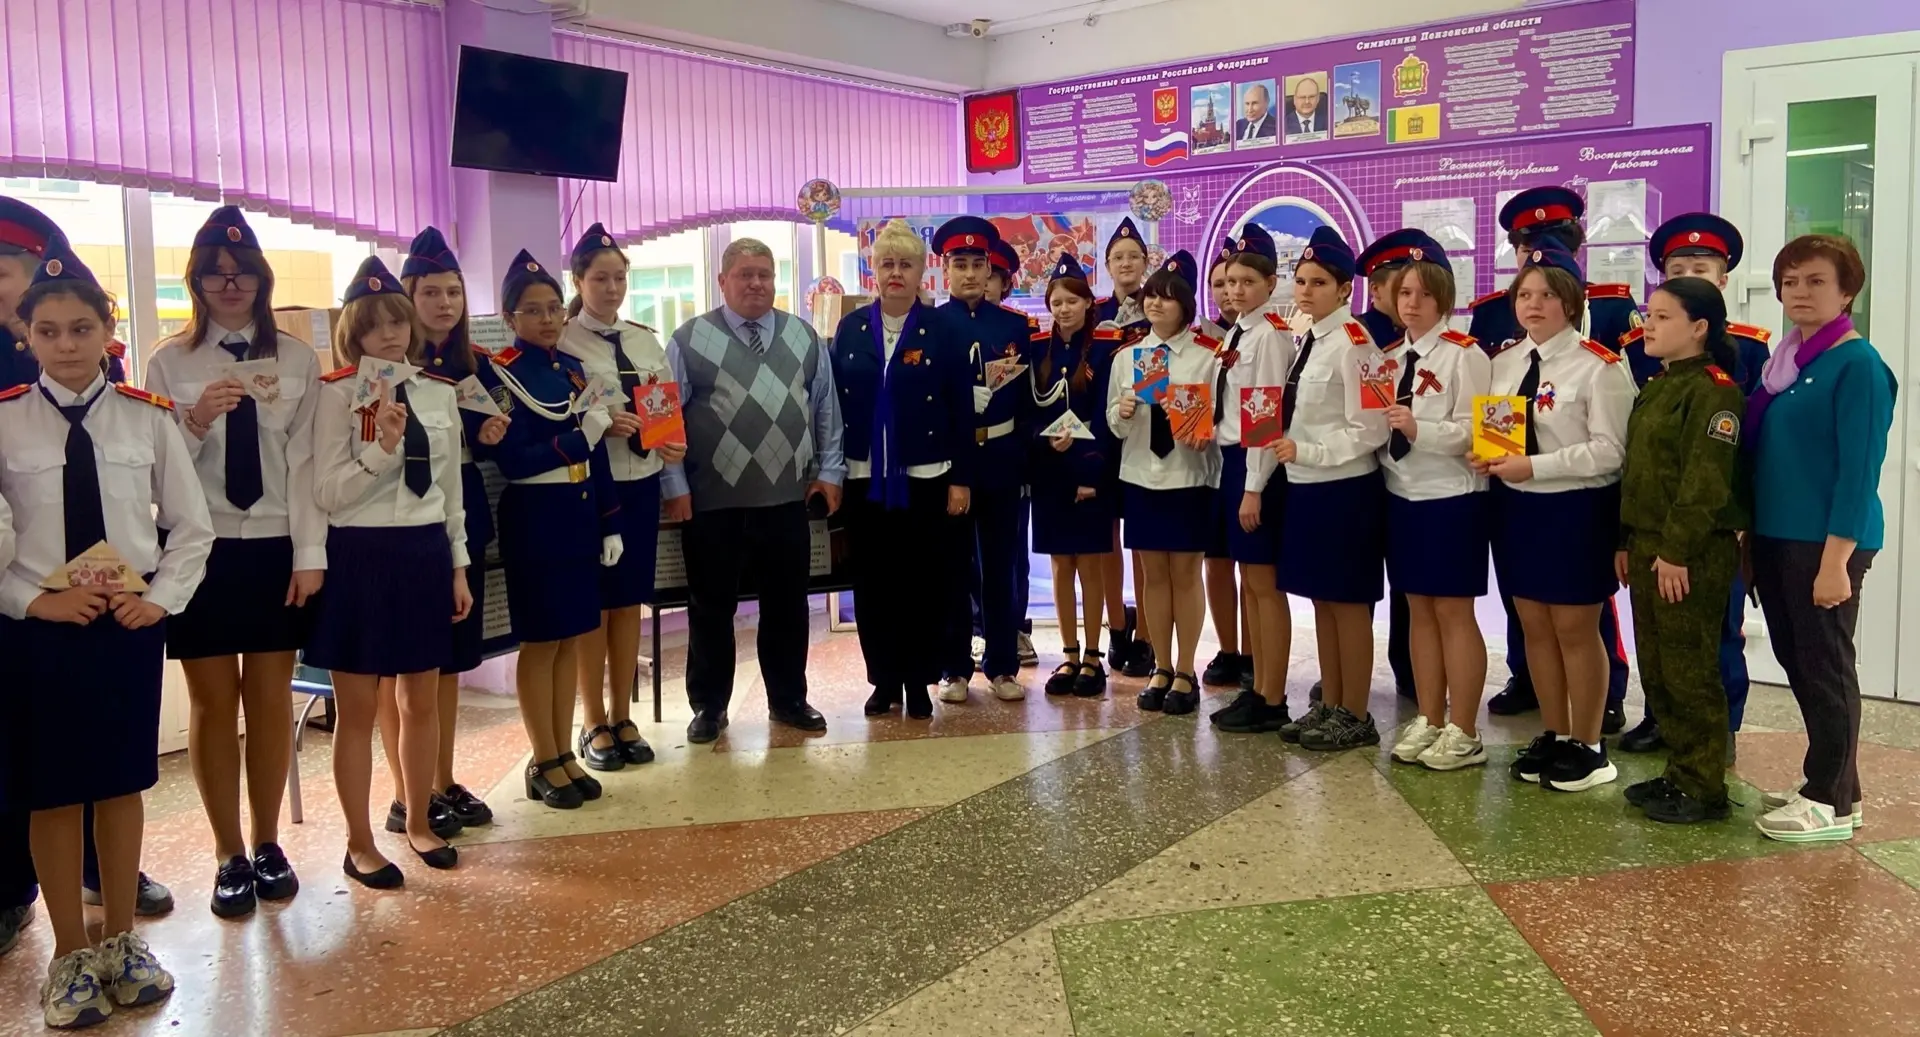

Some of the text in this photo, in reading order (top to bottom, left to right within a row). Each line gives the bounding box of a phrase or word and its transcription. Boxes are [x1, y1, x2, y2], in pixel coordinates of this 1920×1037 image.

[1356, 16, 1542, 51] Символика Пензенской области
[1048, 56, 1269, 95] Государственные символы Российской Федерации
[1578, 145, 1694, 162] Воспитательная
[1438, 158, 1505, 171] Расписание
[1608, 156, 1658, 174] работа
[1393, 162, 1560, 189] дополнительного образования
[1361, 363, 1370, 378] 9
[646, 398, 653, 412] 9
[1175, 399, 1184, 411] 9
[1249, 401, 1256, 415] 9
[1486, 406, 1496, 420] 9
